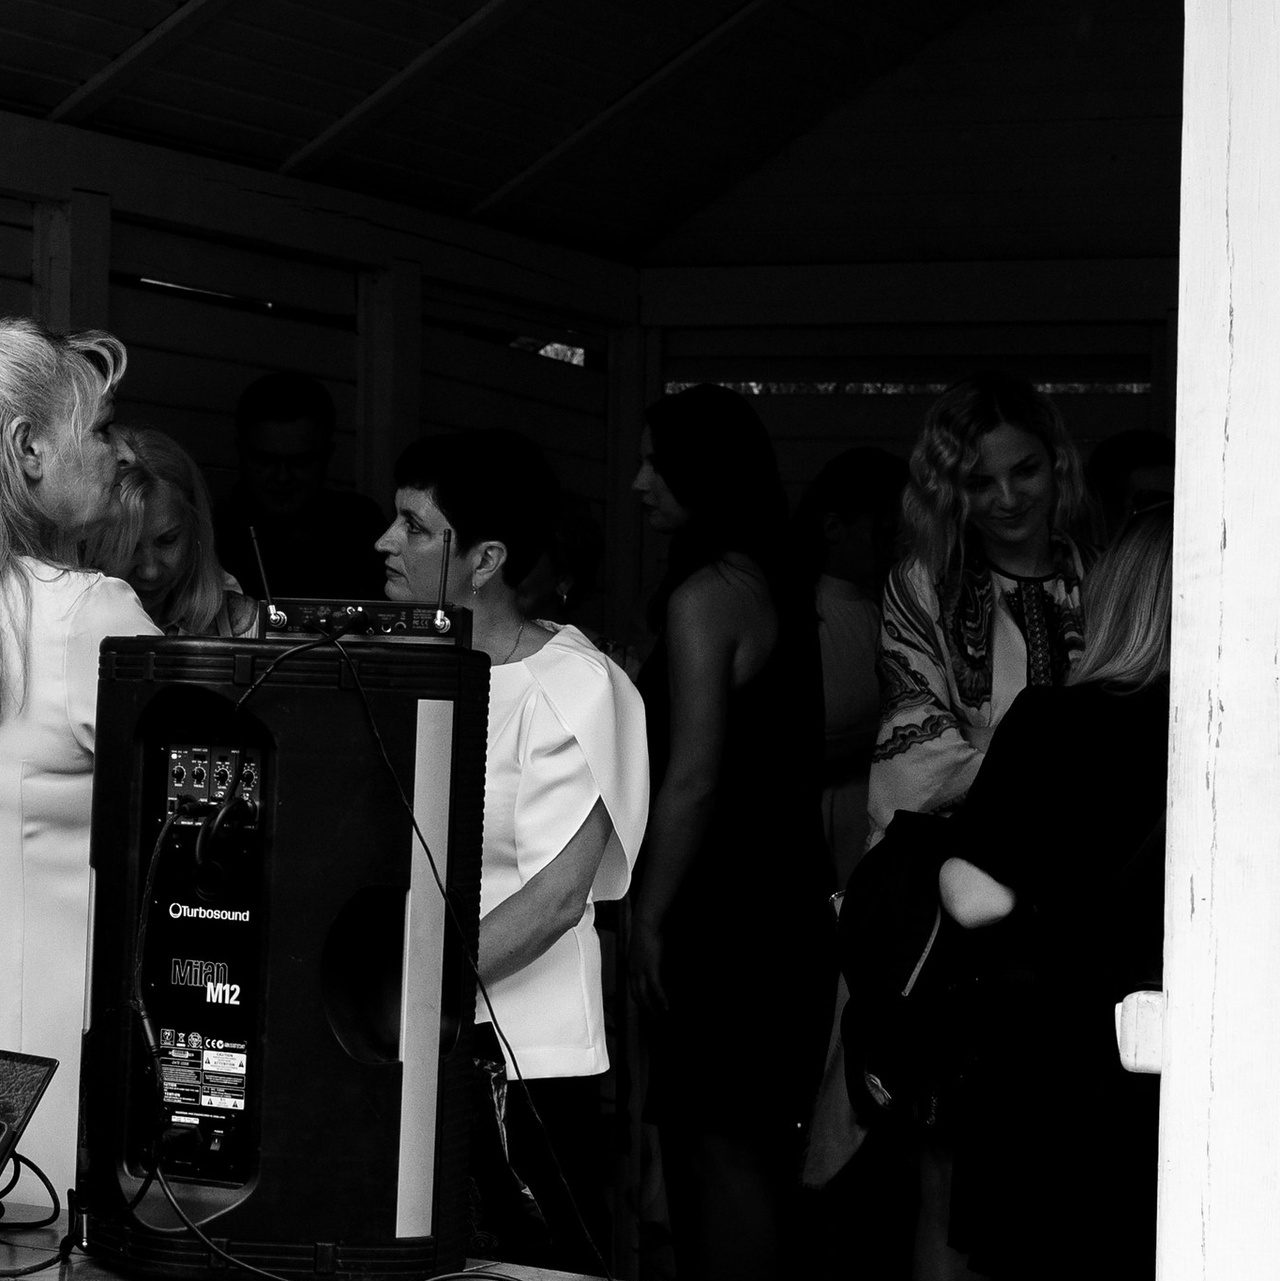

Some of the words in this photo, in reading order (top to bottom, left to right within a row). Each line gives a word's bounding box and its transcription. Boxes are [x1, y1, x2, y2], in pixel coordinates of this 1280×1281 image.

[182, 905, 250, 922] Turbosound
[171, 958, 228, 988] Milan
[206, 982, 241, 1005] M12
